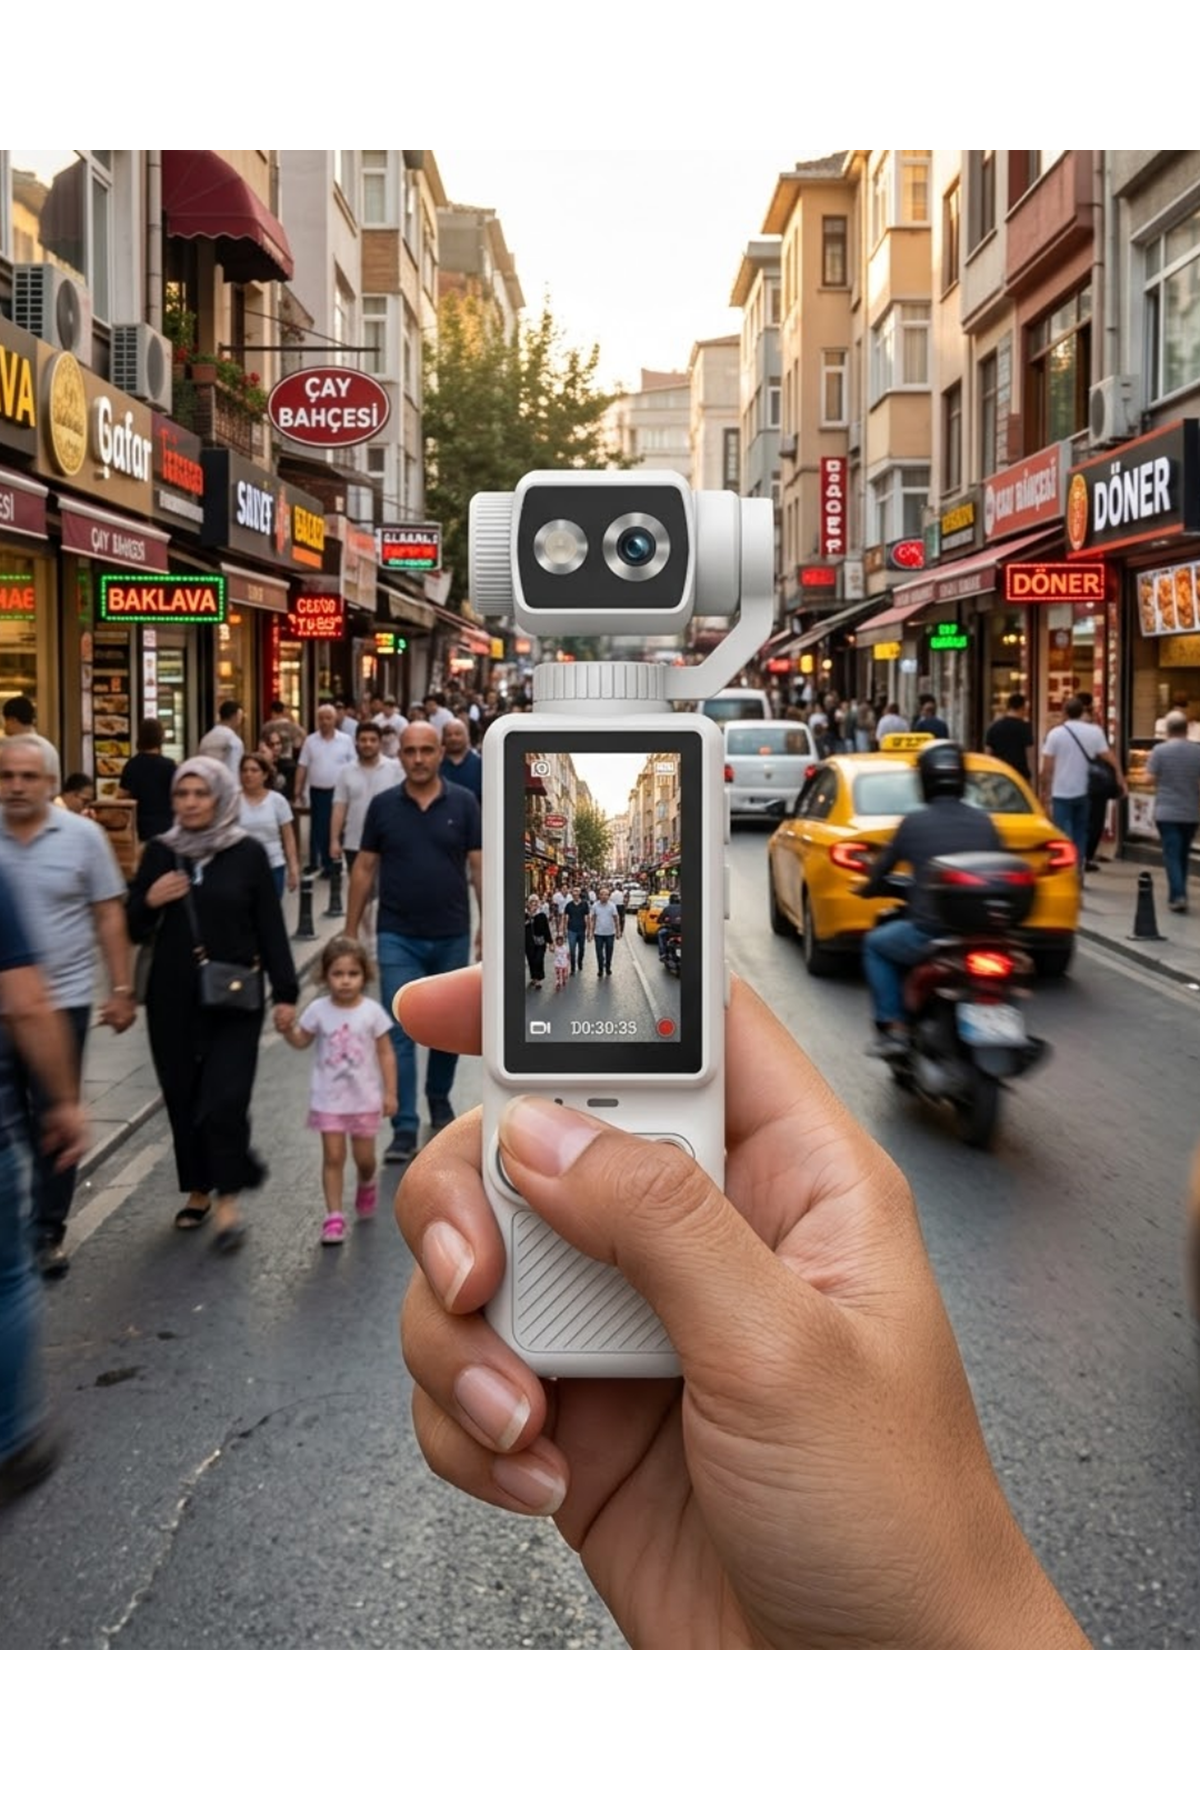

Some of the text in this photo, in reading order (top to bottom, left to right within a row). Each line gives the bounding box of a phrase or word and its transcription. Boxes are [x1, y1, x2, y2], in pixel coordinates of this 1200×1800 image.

[305, 377, 351, 403] ÇAY
[279, 403, 378, 433] BAHÇESİ
[1094, 456, 1171, 532] DÖNER
[1013, 568, 1100, 595] DÖNER
[108, 587, 217, 612] BAKLAVA
